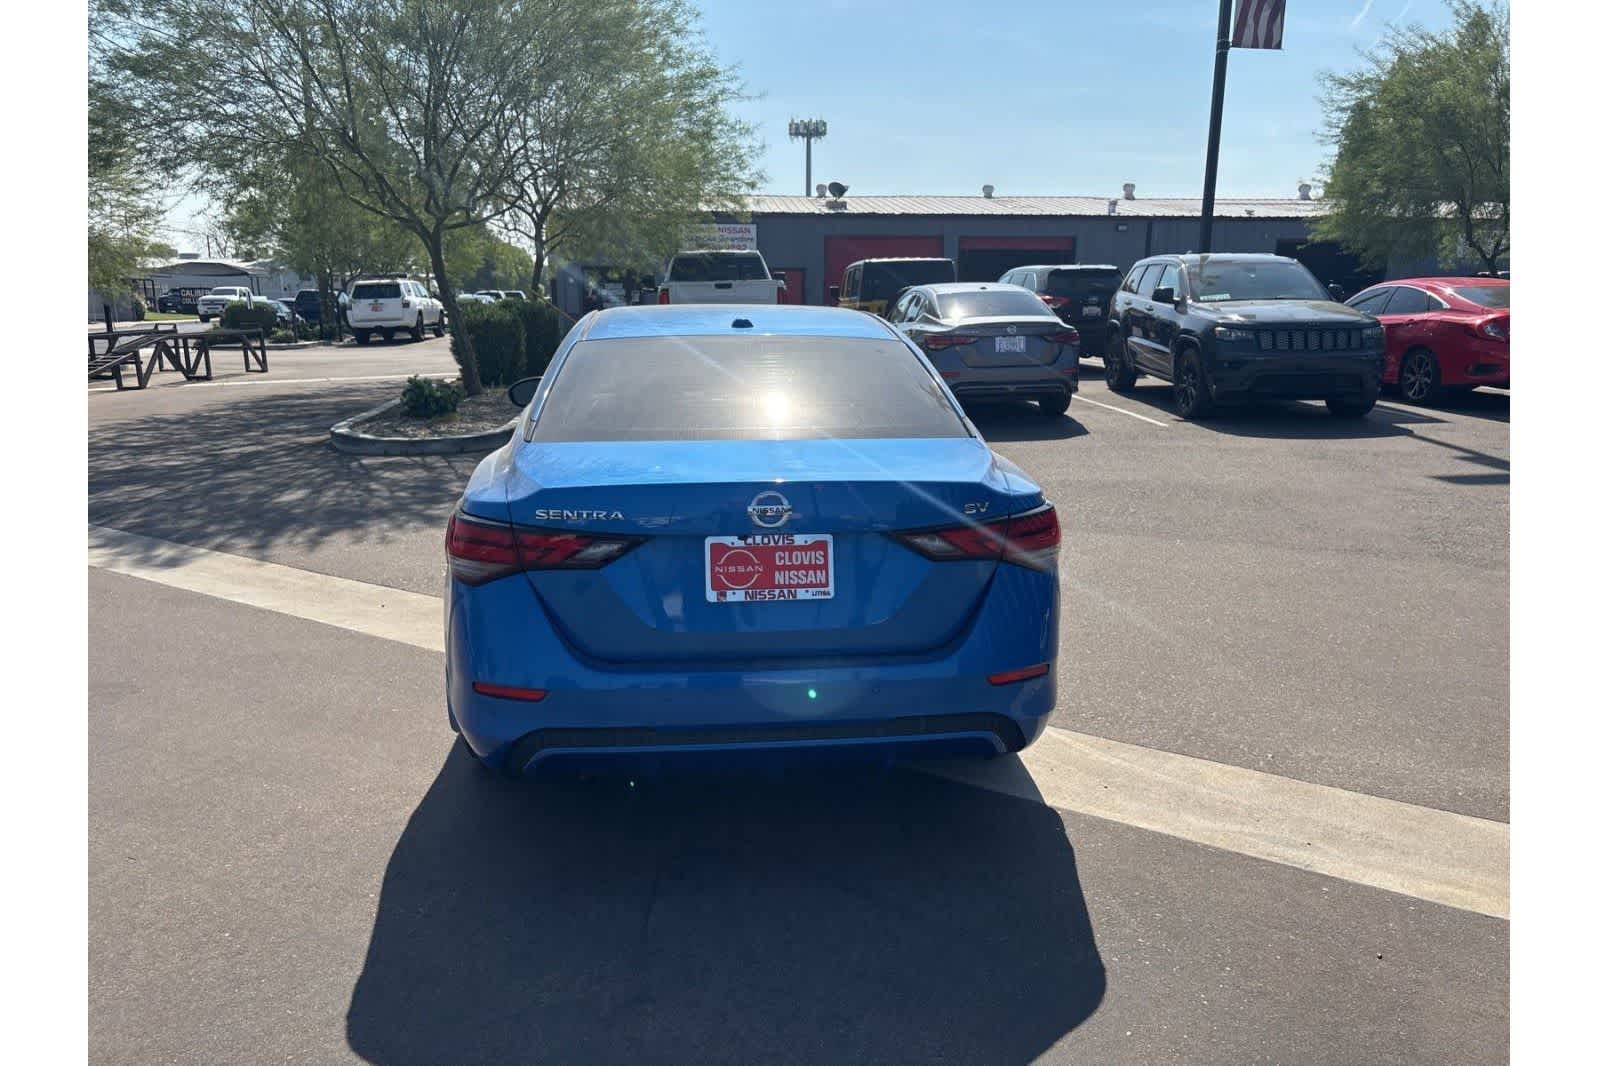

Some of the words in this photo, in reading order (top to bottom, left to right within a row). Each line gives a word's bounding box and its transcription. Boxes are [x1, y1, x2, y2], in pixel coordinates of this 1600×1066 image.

[751, 505, 787, 514] NISSAN
[964, 501, 990, 514] SV
[535, 508, 625, 521] SENTRA
[743, 534, 795, 546] CLOVIS
[775, 551, 825, 565] CLOVIS
[714, 565, 763, 573] NISSAN
[774, 570, 826, 585] NISSAN
[744, 589, 797, 600] NISSAN
